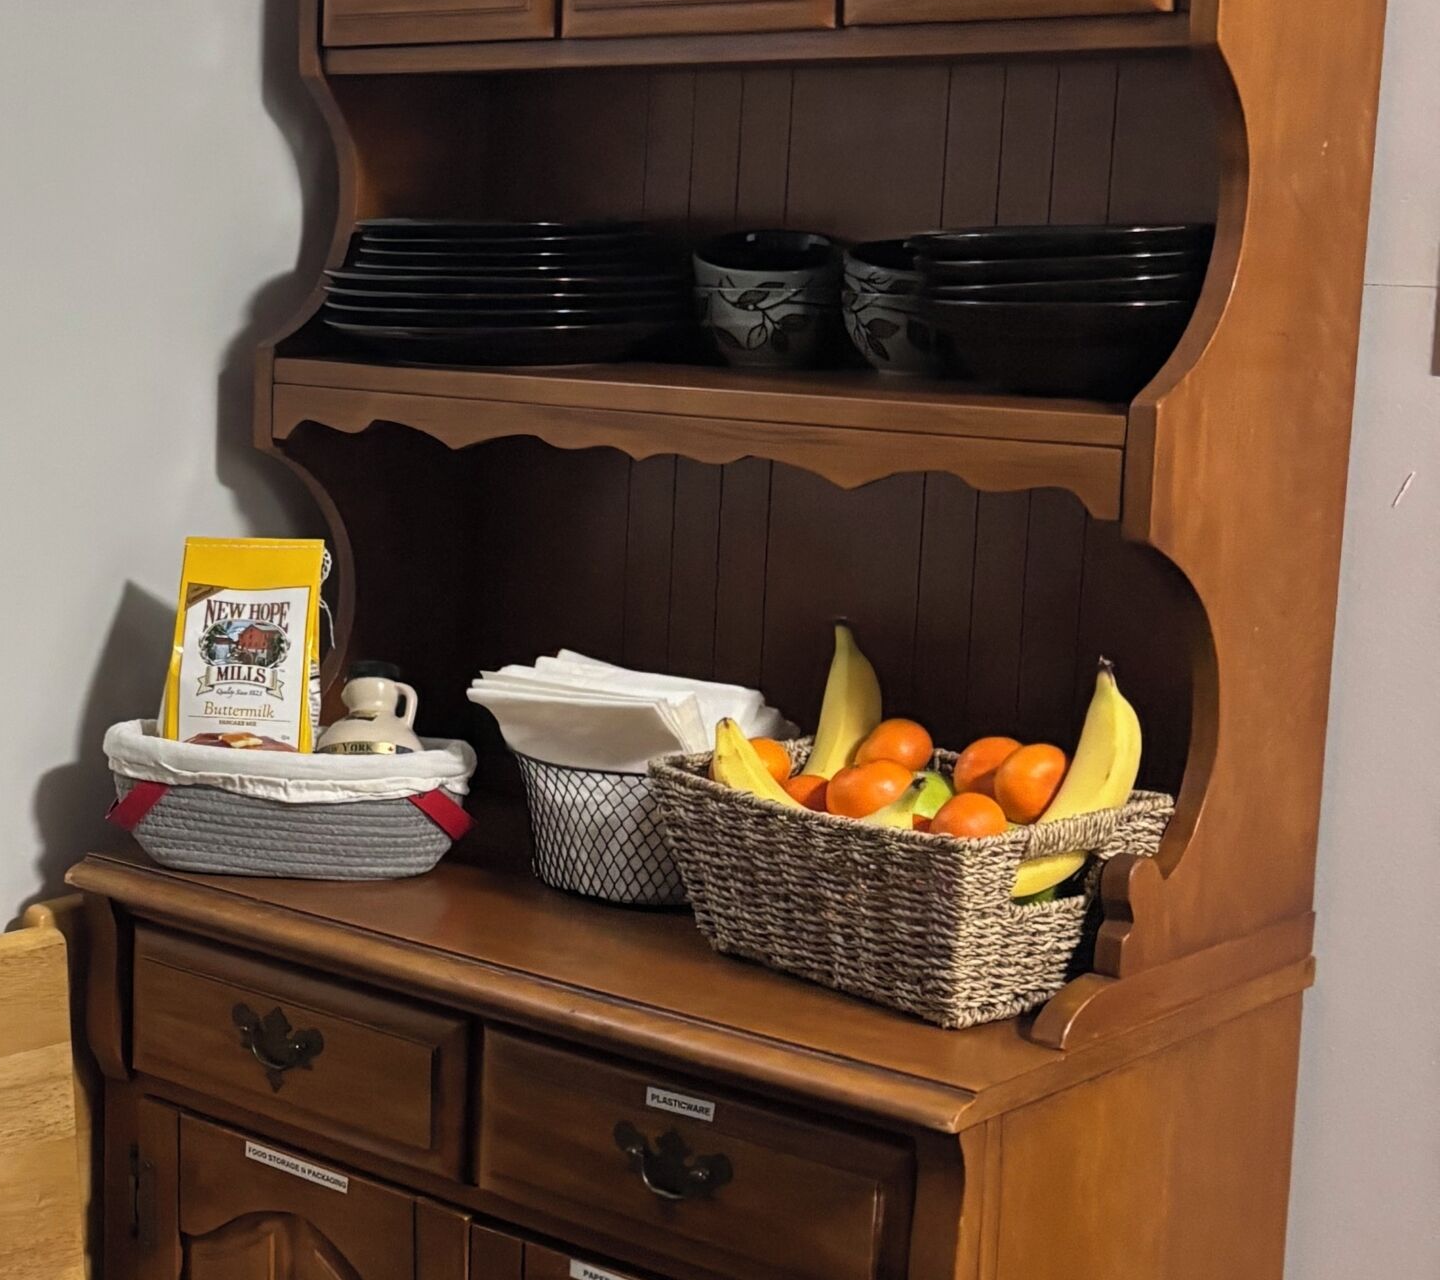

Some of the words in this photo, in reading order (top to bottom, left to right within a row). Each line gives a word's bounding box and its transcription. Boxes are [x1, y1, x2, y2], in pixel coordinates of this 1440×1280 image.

[203, 599, 245, 632] NEW
[249, 601, 291, 634] HOPE
[216, 665, 266, 683] MILLS
[203, 700, 275, 719] Buttermilk
[651, 1093, 711, 1116] PLASTICWARE
[248, 1146, 267, 1160] FOOD
[268, 1153, 300, 1172] STORAGE
[307, 1168, 347, 1189] PACKAGING
